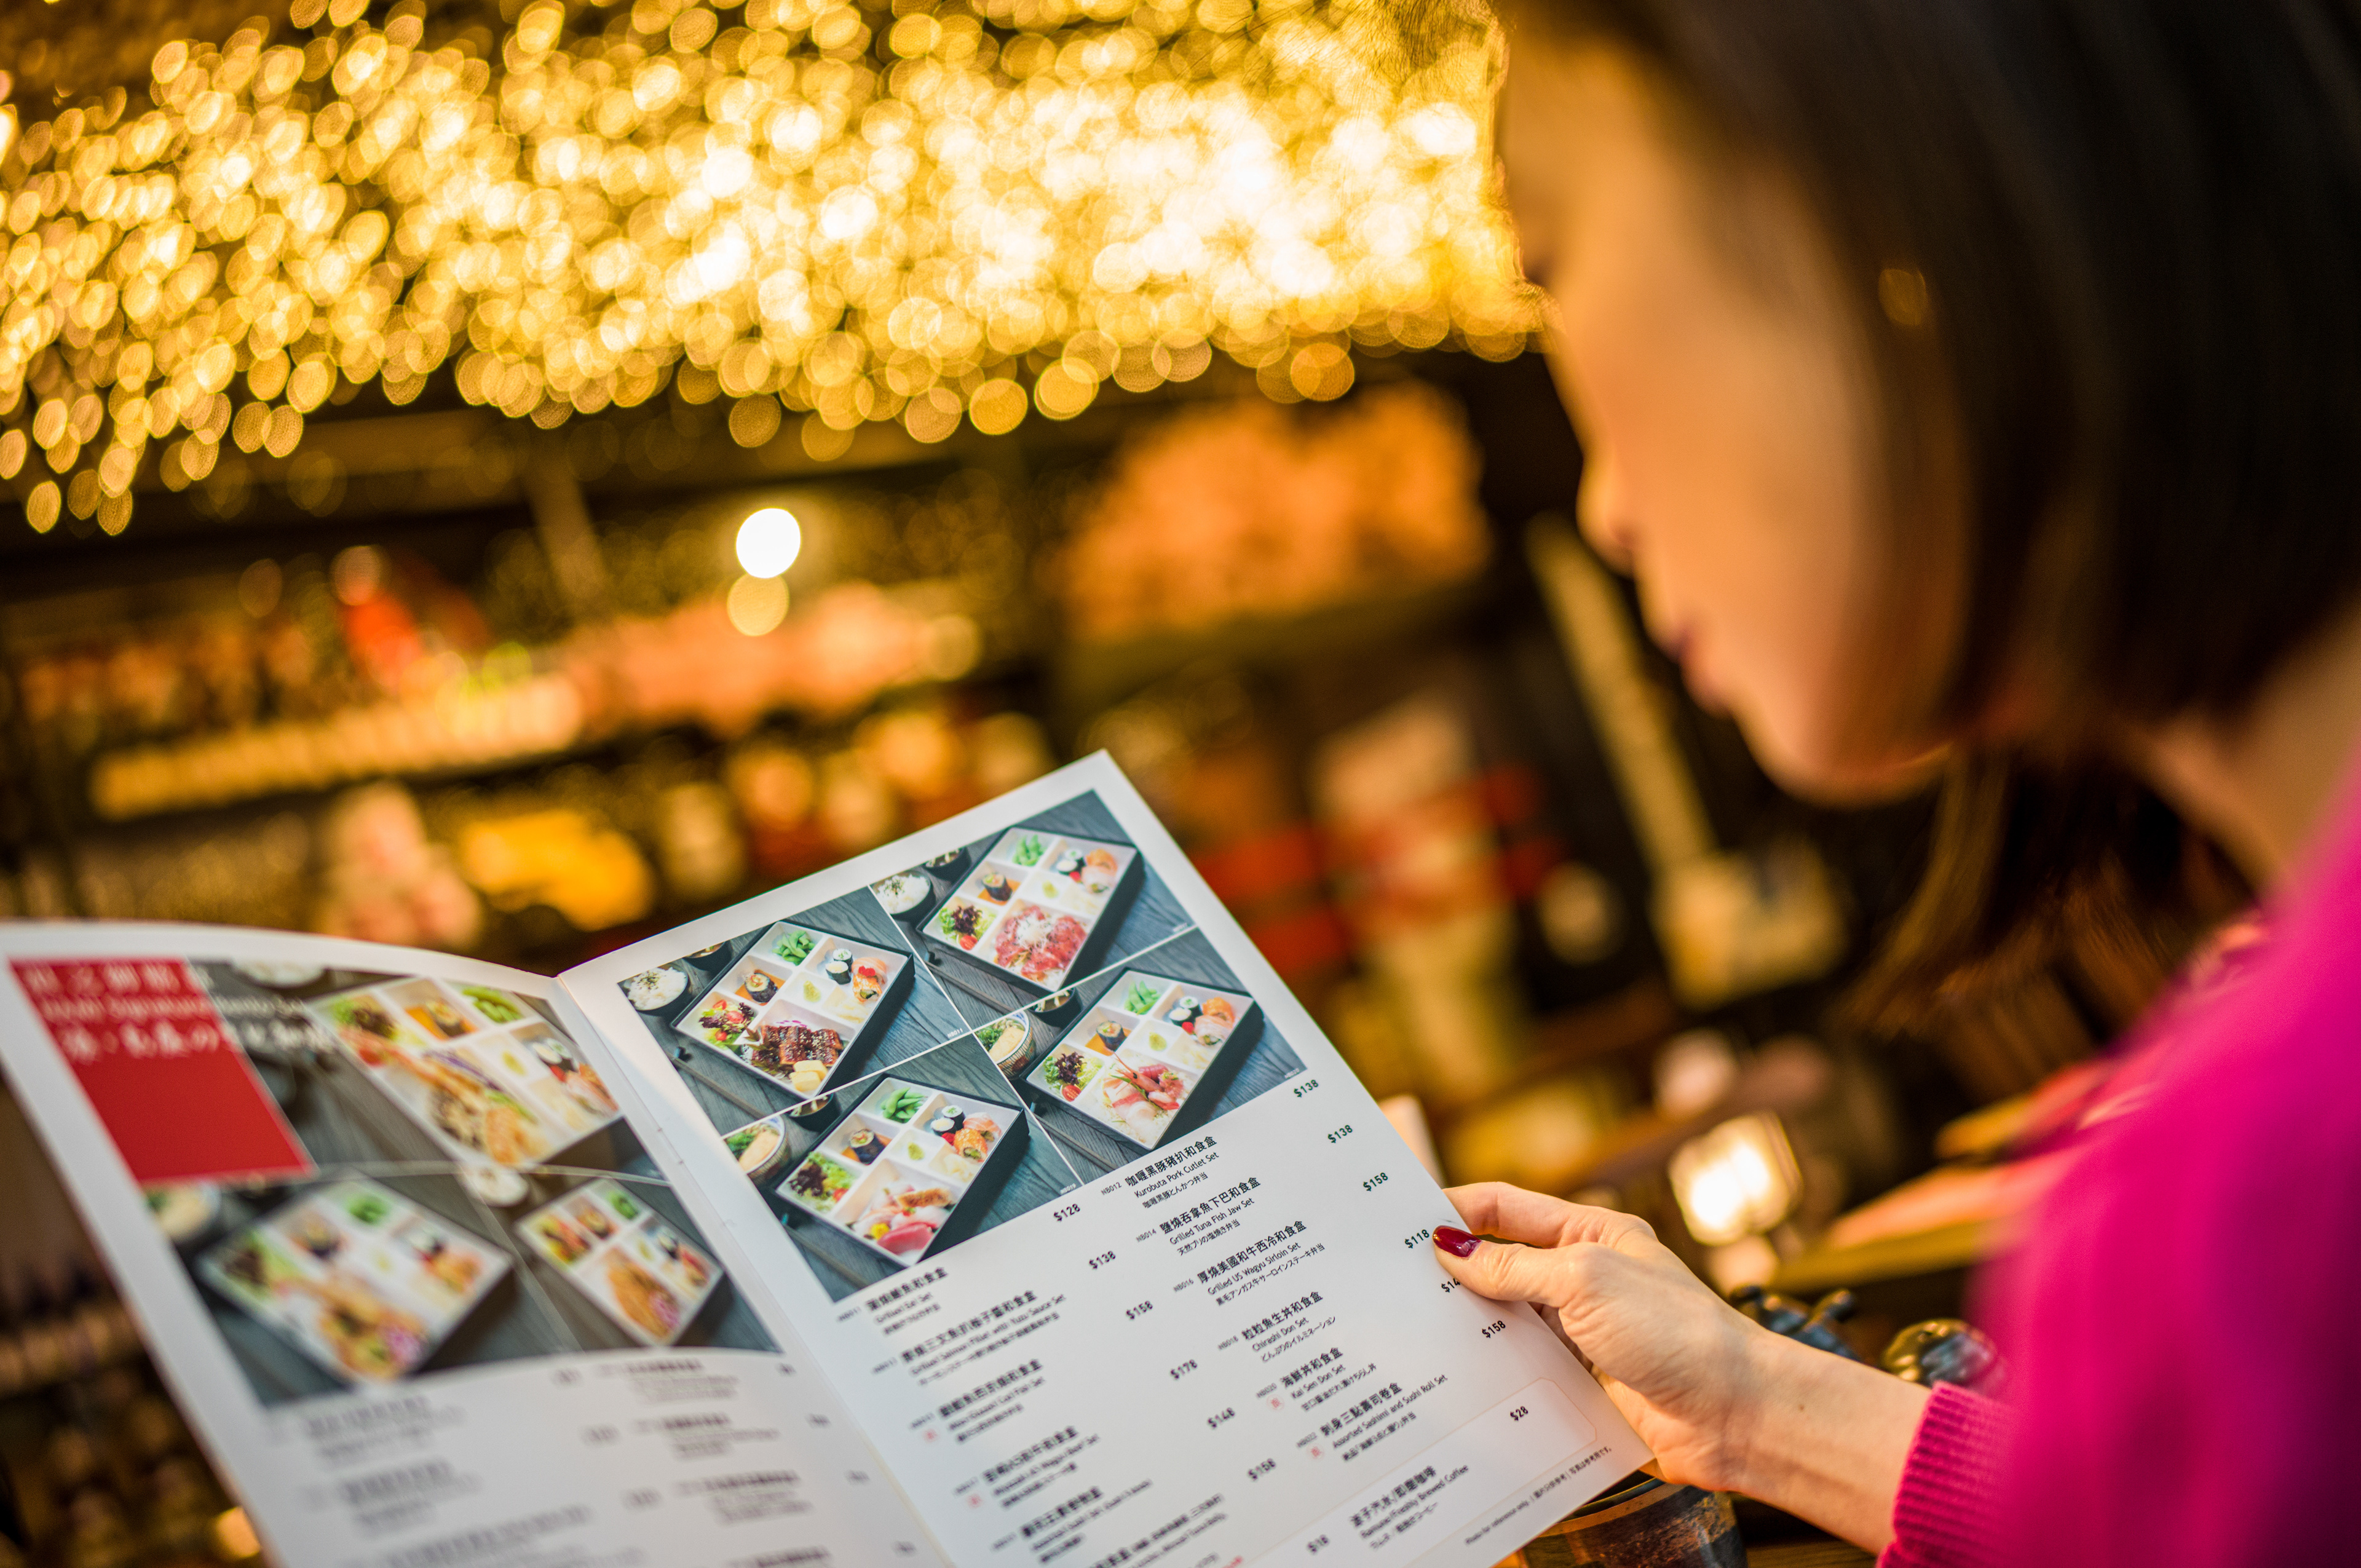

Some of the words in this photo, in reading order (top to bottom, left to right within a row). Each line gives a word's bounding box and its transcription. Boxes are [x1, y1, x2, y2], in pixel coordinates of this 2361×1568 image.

[947, 1028, 963, 1038] NB011
[1284, 1067, 1300, 1079] NB020
[1294, 1080, 1318, 1098] $138
[1328, 1125, 1353, 1143] $138
[1134, 1179, 1167, 1198] Kurobuta
[1166, 1170, 1184, 1182] Pork
[1184, 1159, 1206, 1173] Cutlet
[1206, 1152, 1219, 1162] Set
[1363, 1173, 1388, 1191] $158
[1060, 1183, 1076, 1194] NB019
[1101, 1182, 1121, 1195] NB012
[1054, 1204, 1080, 1221] $128
[1170, 1228, 1195, 1245] Grilled
[1193, 1221, 1212, 1232] Tuna
[1211, 1213, 1227, 1223] Fish
[1228, 1205, 1241, 1215] Jaw
[1241, 1198, 1254, 1208] Set
[1136, 1229, 1157, 1242] NB014
[1405, 1229, 1430, 1248] $118
[1089, 1251, 1115, 1269] $138
[1197, 1221, 1307, 1283] 厚燒美國和牛西冷和食盒
[1208, 1278, 1233, 1295] Grilled
[1232, 1272, 1243, 1281] US
[1242, 1262, 1266, 1276] Wagyu
[1265, 1250, 1288, 1264] Sirloin
[1287, 1243, 1301, 1252] Set
[1174, 1278, 1193, 1292] NB016
[1441, 1277, 1461, 1293] $14
[1126, 1301, 1153, 1320] $158
[1252, 1331, 1281, 1352] Chirashi
[1281, 1325, 1296, 1336] Don
[1295, 1318, 1308, 1327] Set
[1482, 1320, 1506, 1338] $158
[1170, 1360, 1197, 1380] $178
[1280, 1348, 1343, 1388] 海鮮丼和食盒
[1291, 1389, 1304, 1399] Kai
[1303, 1381, 1318, 1392] Sen
[1317, 1372, 1332, 1384] Don
[1332, 1364, 1345, 1375] Set
[1333, 1425, 1363, 1449] Assorted
[1362, 1409, 1390, 1430] Sashimi
[1390, 1400, 1404, 1413] and
[1402, 1389, 1422, 1404] Sushi
[1420, 1380, 1436, 1393] Roll
[1434, 1375, 1447, 1385] Set
[1510, 1406, 1528, 1421] $28
[1417, 1479, 1445, 1501] Brewed
[1444, 1465, 1468, 1483] Coffee
